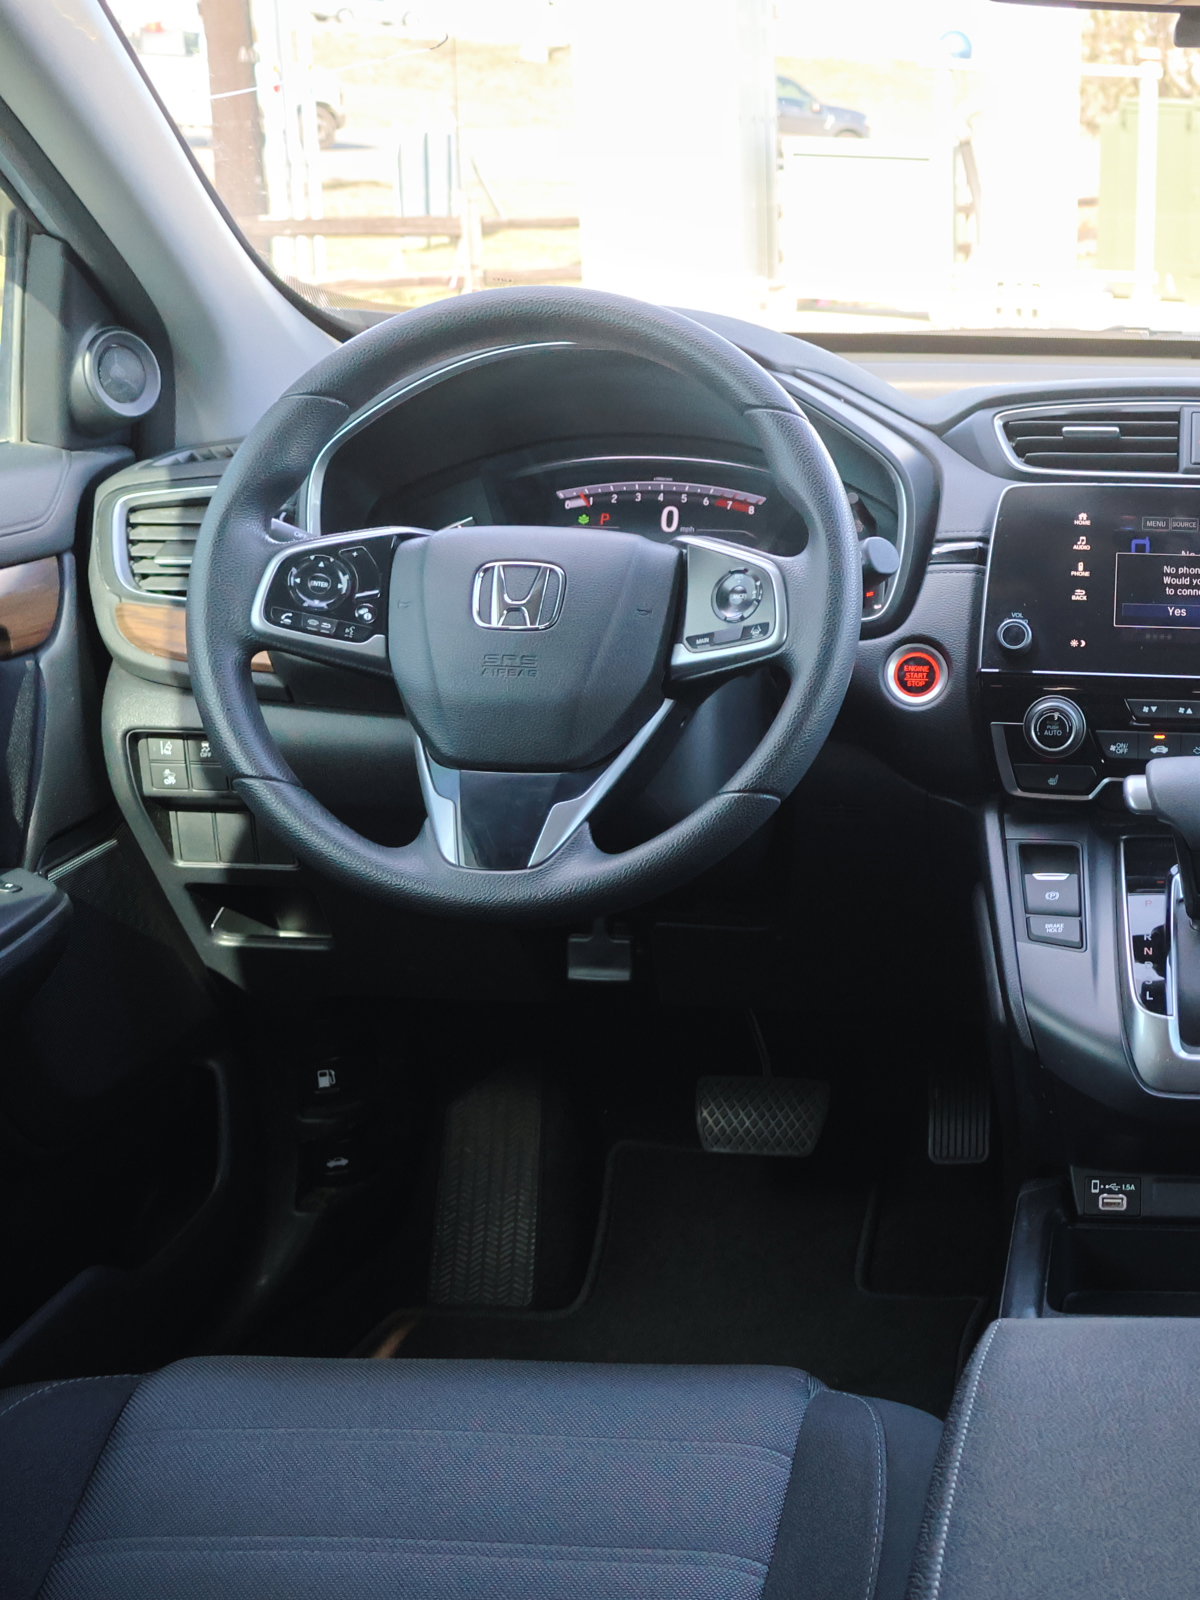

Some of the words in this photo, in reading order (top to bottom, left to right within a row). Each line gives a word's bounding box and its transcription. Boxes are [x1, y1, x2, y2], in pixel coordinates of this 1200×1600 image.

[611, 494, 618, 503] 2
[635, 492, 642, 502] 3
[657, 492, 664, 502] 4
[681, 493, 688, 503] 5
[703, 497, 710, 506] 6
[726, 500, 733, 510] 7
[748, 505, 755, 515] 8
[600, 512, 611, 525] P
[660, 505, 679, 533] 0
[680, 526, 695, 534] mph
[1146, 520, 1166, 528] MENU
[1172, 521, 1197, 529] SOURCE
[1163, 566, 1176, 575] No
[310, 580, 329, 588] ENTER
[1163, 577, 1190, 585] Would
[1166, 587, 1175, 596] to
[1167, 606, 1187, 617] Yes
[1143, 947, 1153, 955] N
[1146, 991, 1154, 1000] L
